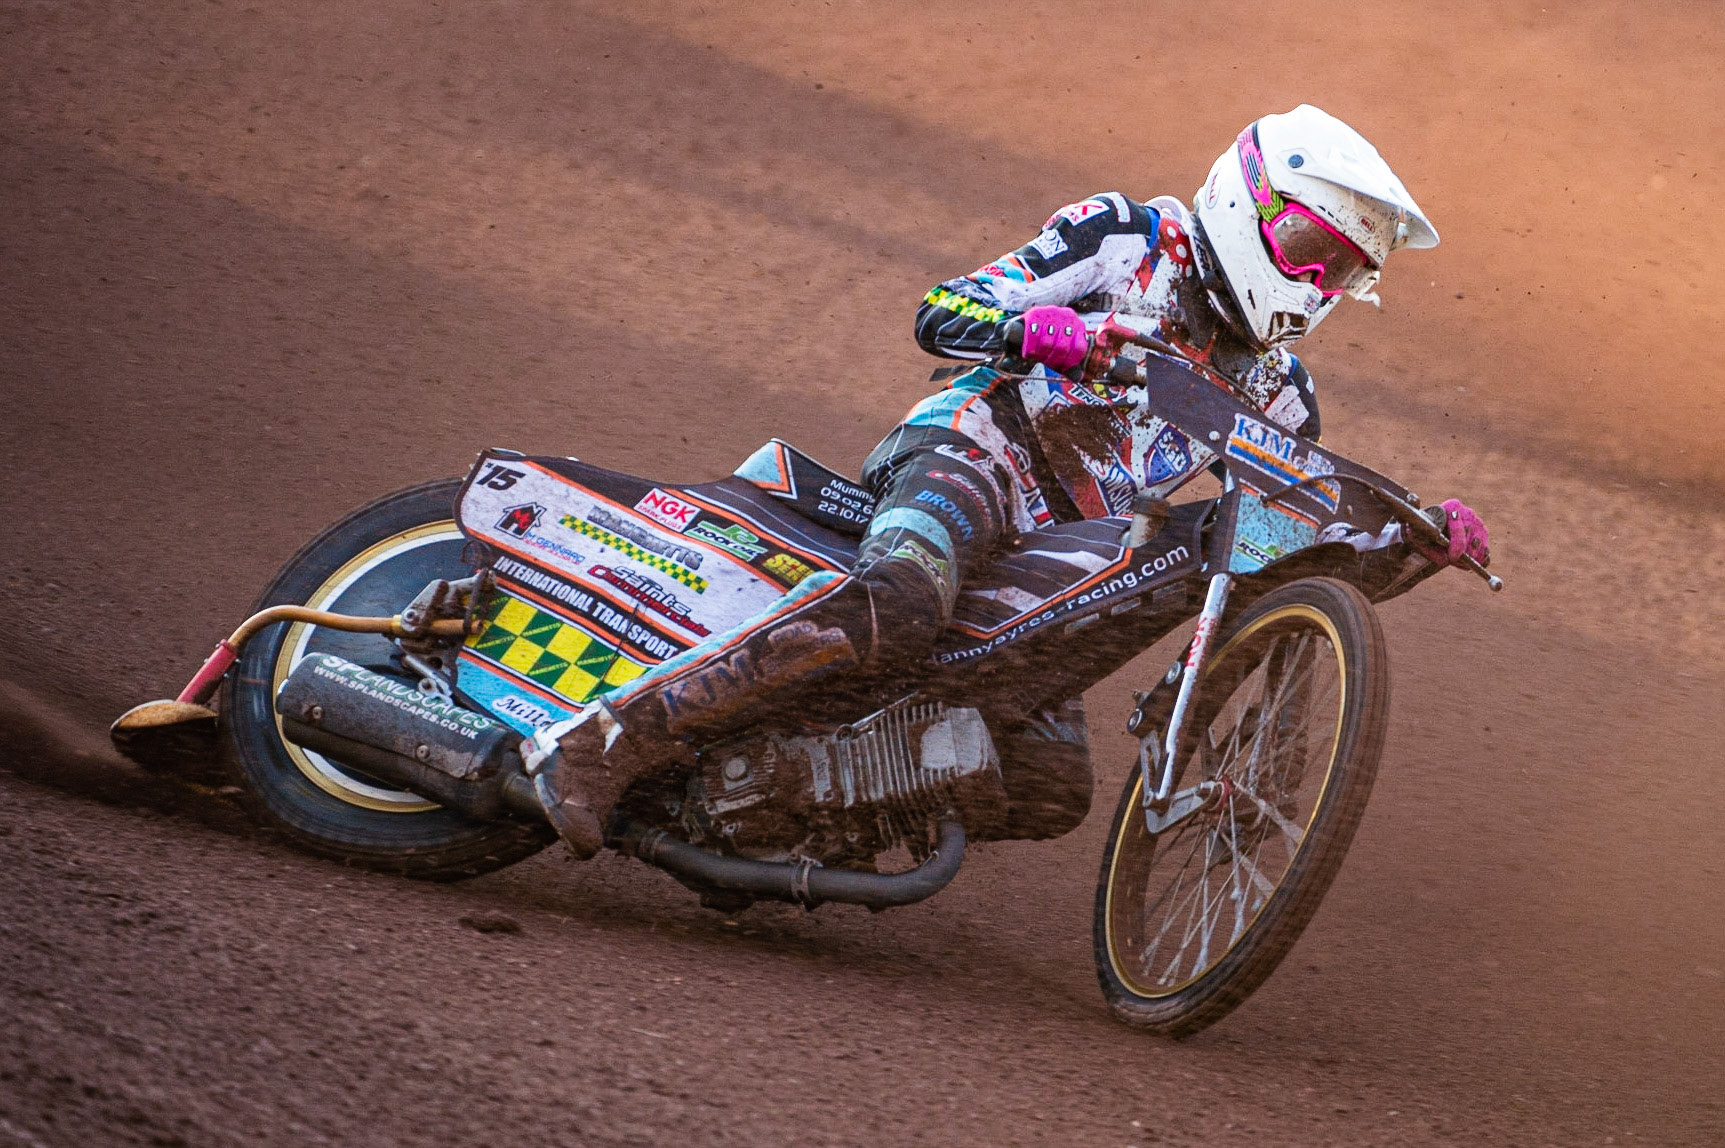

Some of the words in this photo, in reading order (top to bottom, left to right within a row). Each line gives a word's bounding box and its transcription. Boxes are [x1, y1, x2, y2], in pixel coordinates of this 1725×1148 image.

[643, 492, 696, 523] NGK
[818, 500, 869, 524] 22.10.17
[820, 487, 874, 515] 09.02.6
[660, 517, 682, 531] PLUGS
[494, 556, 598, 613] INTERNATIONAL
[591, 601, 679, 661] TRANSPORT
[313, 664, 480, 740] WWW.SPLANDSCAPES.CO.UK
